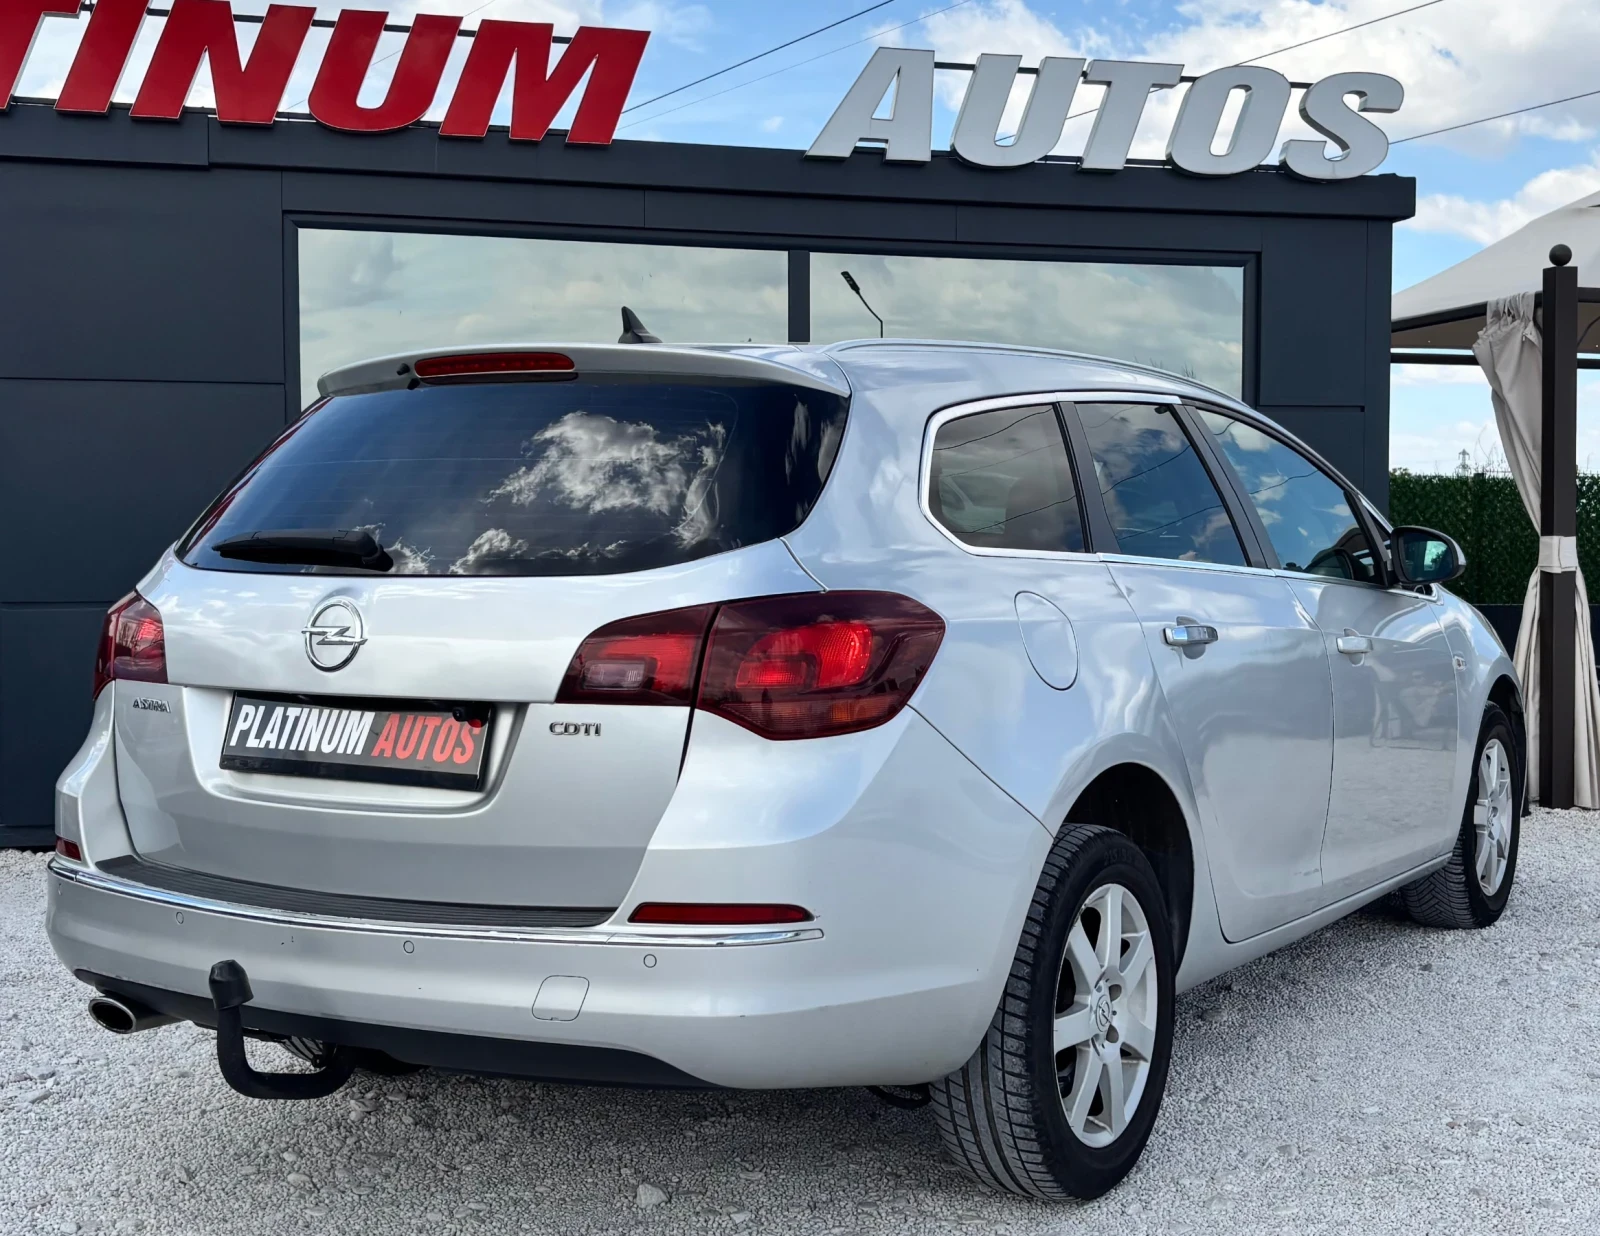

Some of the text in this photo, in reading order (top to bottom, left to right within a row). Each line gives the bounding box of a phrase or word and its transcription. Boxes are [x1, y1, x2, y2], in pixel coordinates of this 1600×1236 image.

[804, 46, 1404, 181] AUTOS
[132, 697, 171, 713] ASTRA
[229, 704, 480, 765] PLATINUM AUTOS
[549, 721, 602, 736] CDTI
